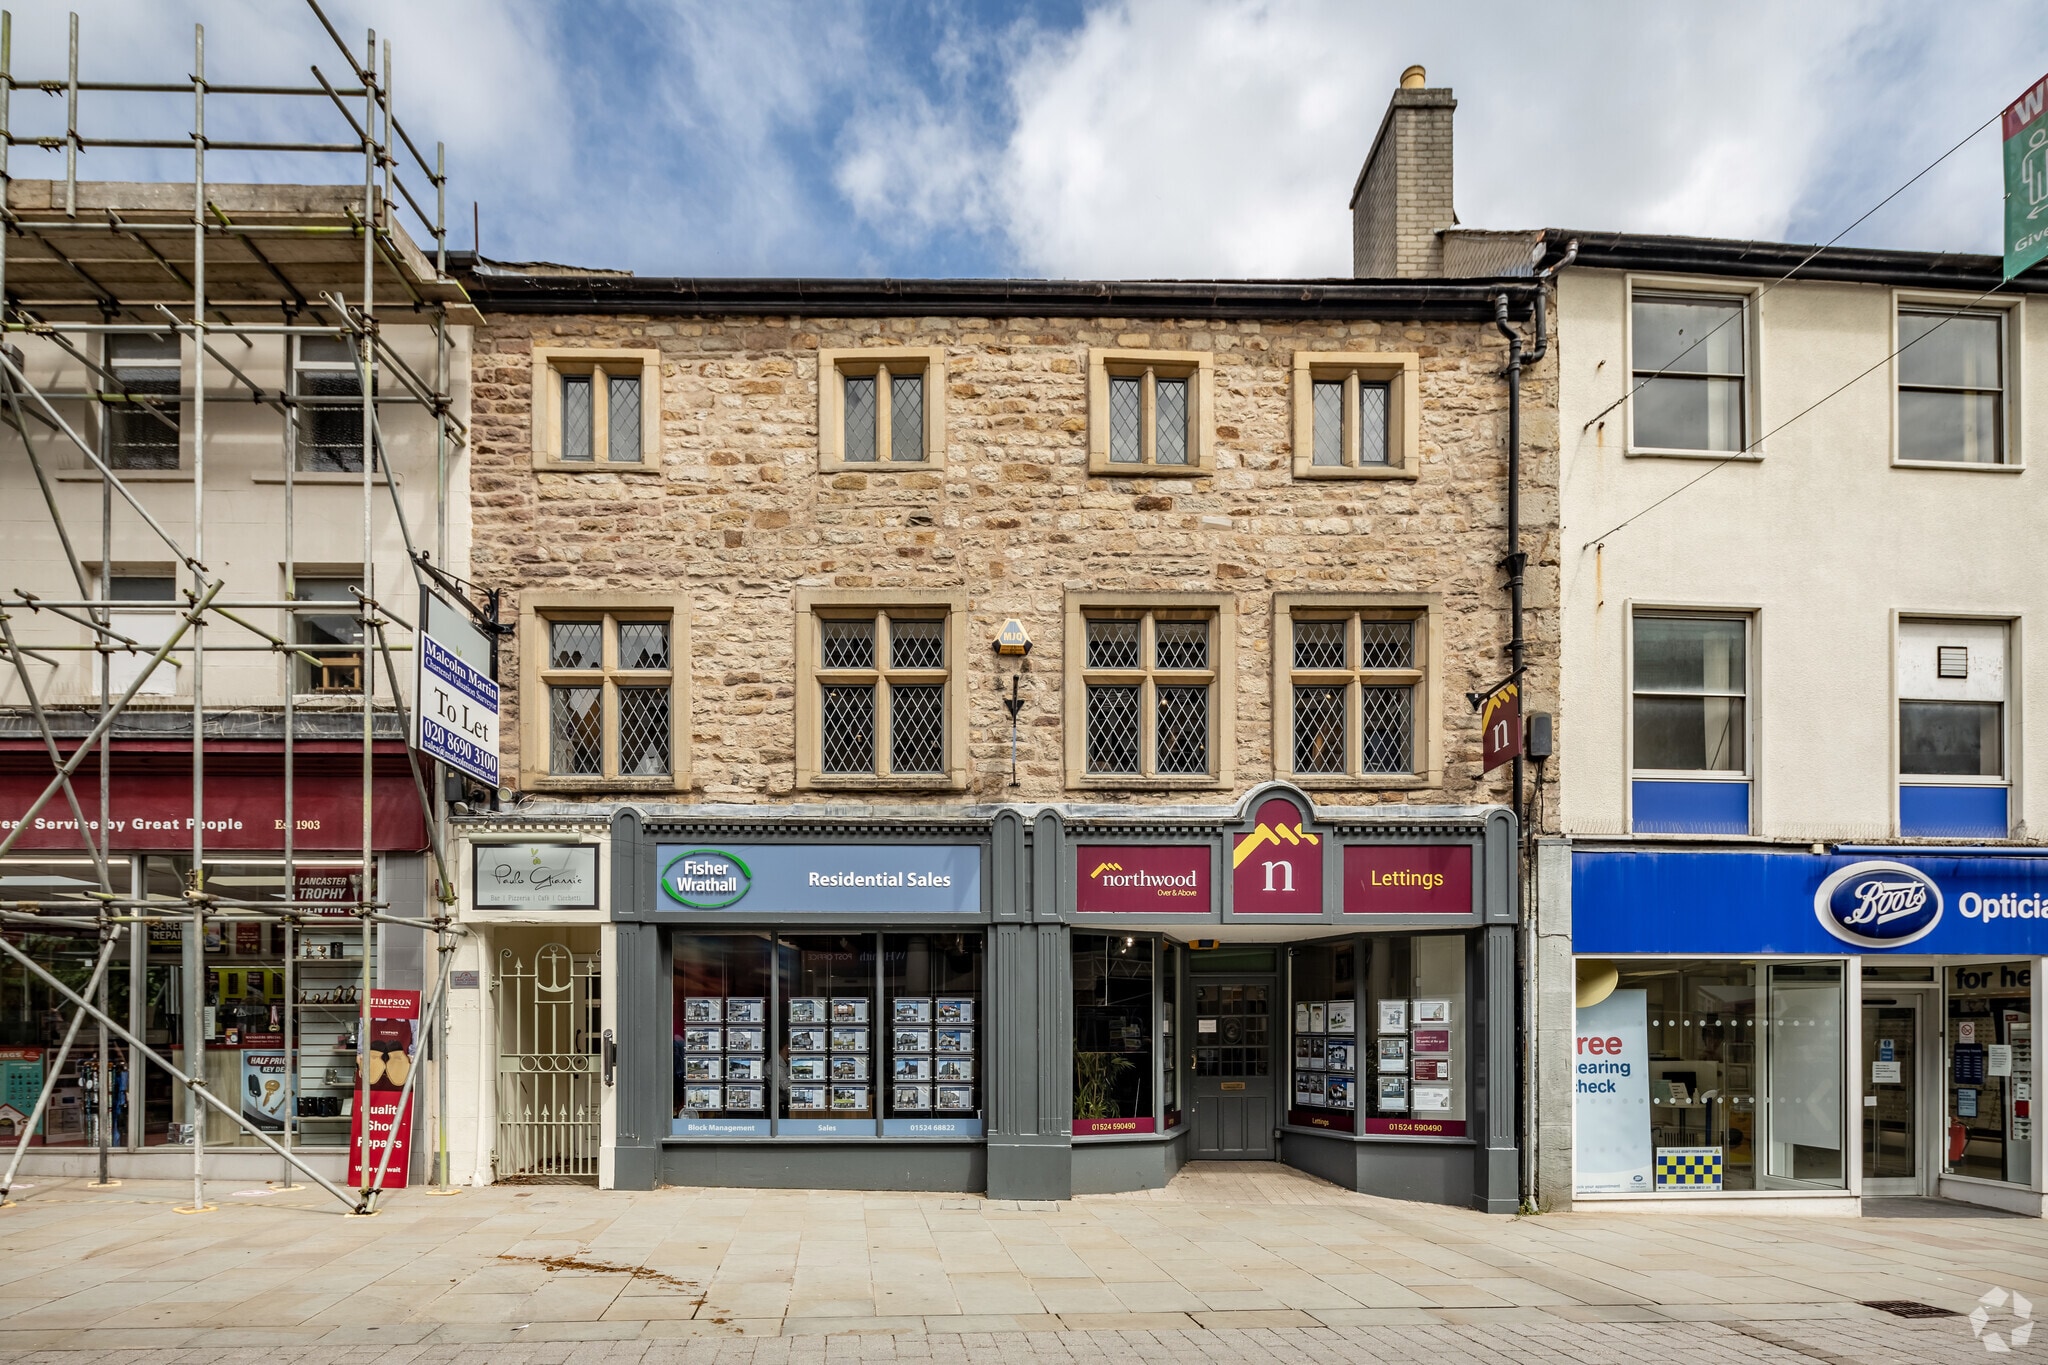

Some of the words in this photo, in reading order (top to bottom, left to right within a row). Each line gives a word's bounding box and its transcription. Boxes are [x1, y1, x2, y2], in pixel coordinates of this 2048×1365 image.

[2014, 78, 2048, 125] W
[425, 638, 467, 680] Malcolm
[468, 669, 497, 701] Martin
[425, 656, 452, 682] Chartered
[452, 674, 476, 697] Valuation
[434, 686, 456, 723] To
[462, 704, 489, 742] Let
[1492, 719, 1510, 753] n
[424, 719, 445, 745] 020
[447, 732, 472, 760] 8690
[473, 747, 497, 773] 3100
[34, 818, 99, 830] Servie
[107, 819, 126, 832] by
[132, 818, 179, 830] Great
[295, 820, 321, 830] 1903
[684, 860, 729, 875] Fisher
[299, 877, 347, 886] LANCASTER
[808, 871, 903, 887] Residential
[907, 872, 951, 887] Sales
[1103, 869, 1197, 887] northwood
[1261, 860, 1296, 892] n
[1371, 869, 1444, 890] Lettings
[676, 877, 737, 892] Wrathall
[299, 888, 346, 899] TROPHY
[1157, 889, 1171, 897] Over
[1178, 889, 1197, 897] Above
[1843, 880, 1928, 926] Boots
[152, 931, 182, 940] REPAI
[1955, 967, 1993, 990] for
[370, 997, 412, 1006] TIMPSON
[269, 1057, 286, 1065] PRIC
[1576, 1060, 1631, 1077] earing
[1576, 1079, 1616, 1093] heck
[360, 1104, 398, 1115] ualit
[688, 1124, 708, 1132] Block
[708, 1124, 755, 1133] Management
[818, 1124, 837, 1132] Sales
[1091, 1122, 1112, 1131] 01524
[1112, 1122, 1136, 1131] 590490
[1311, 1117, 1330, 1127] Lettings
[1389, 1123, 1413, 1131] 01524
[1414, 1124, 1443, 1132] 590490
